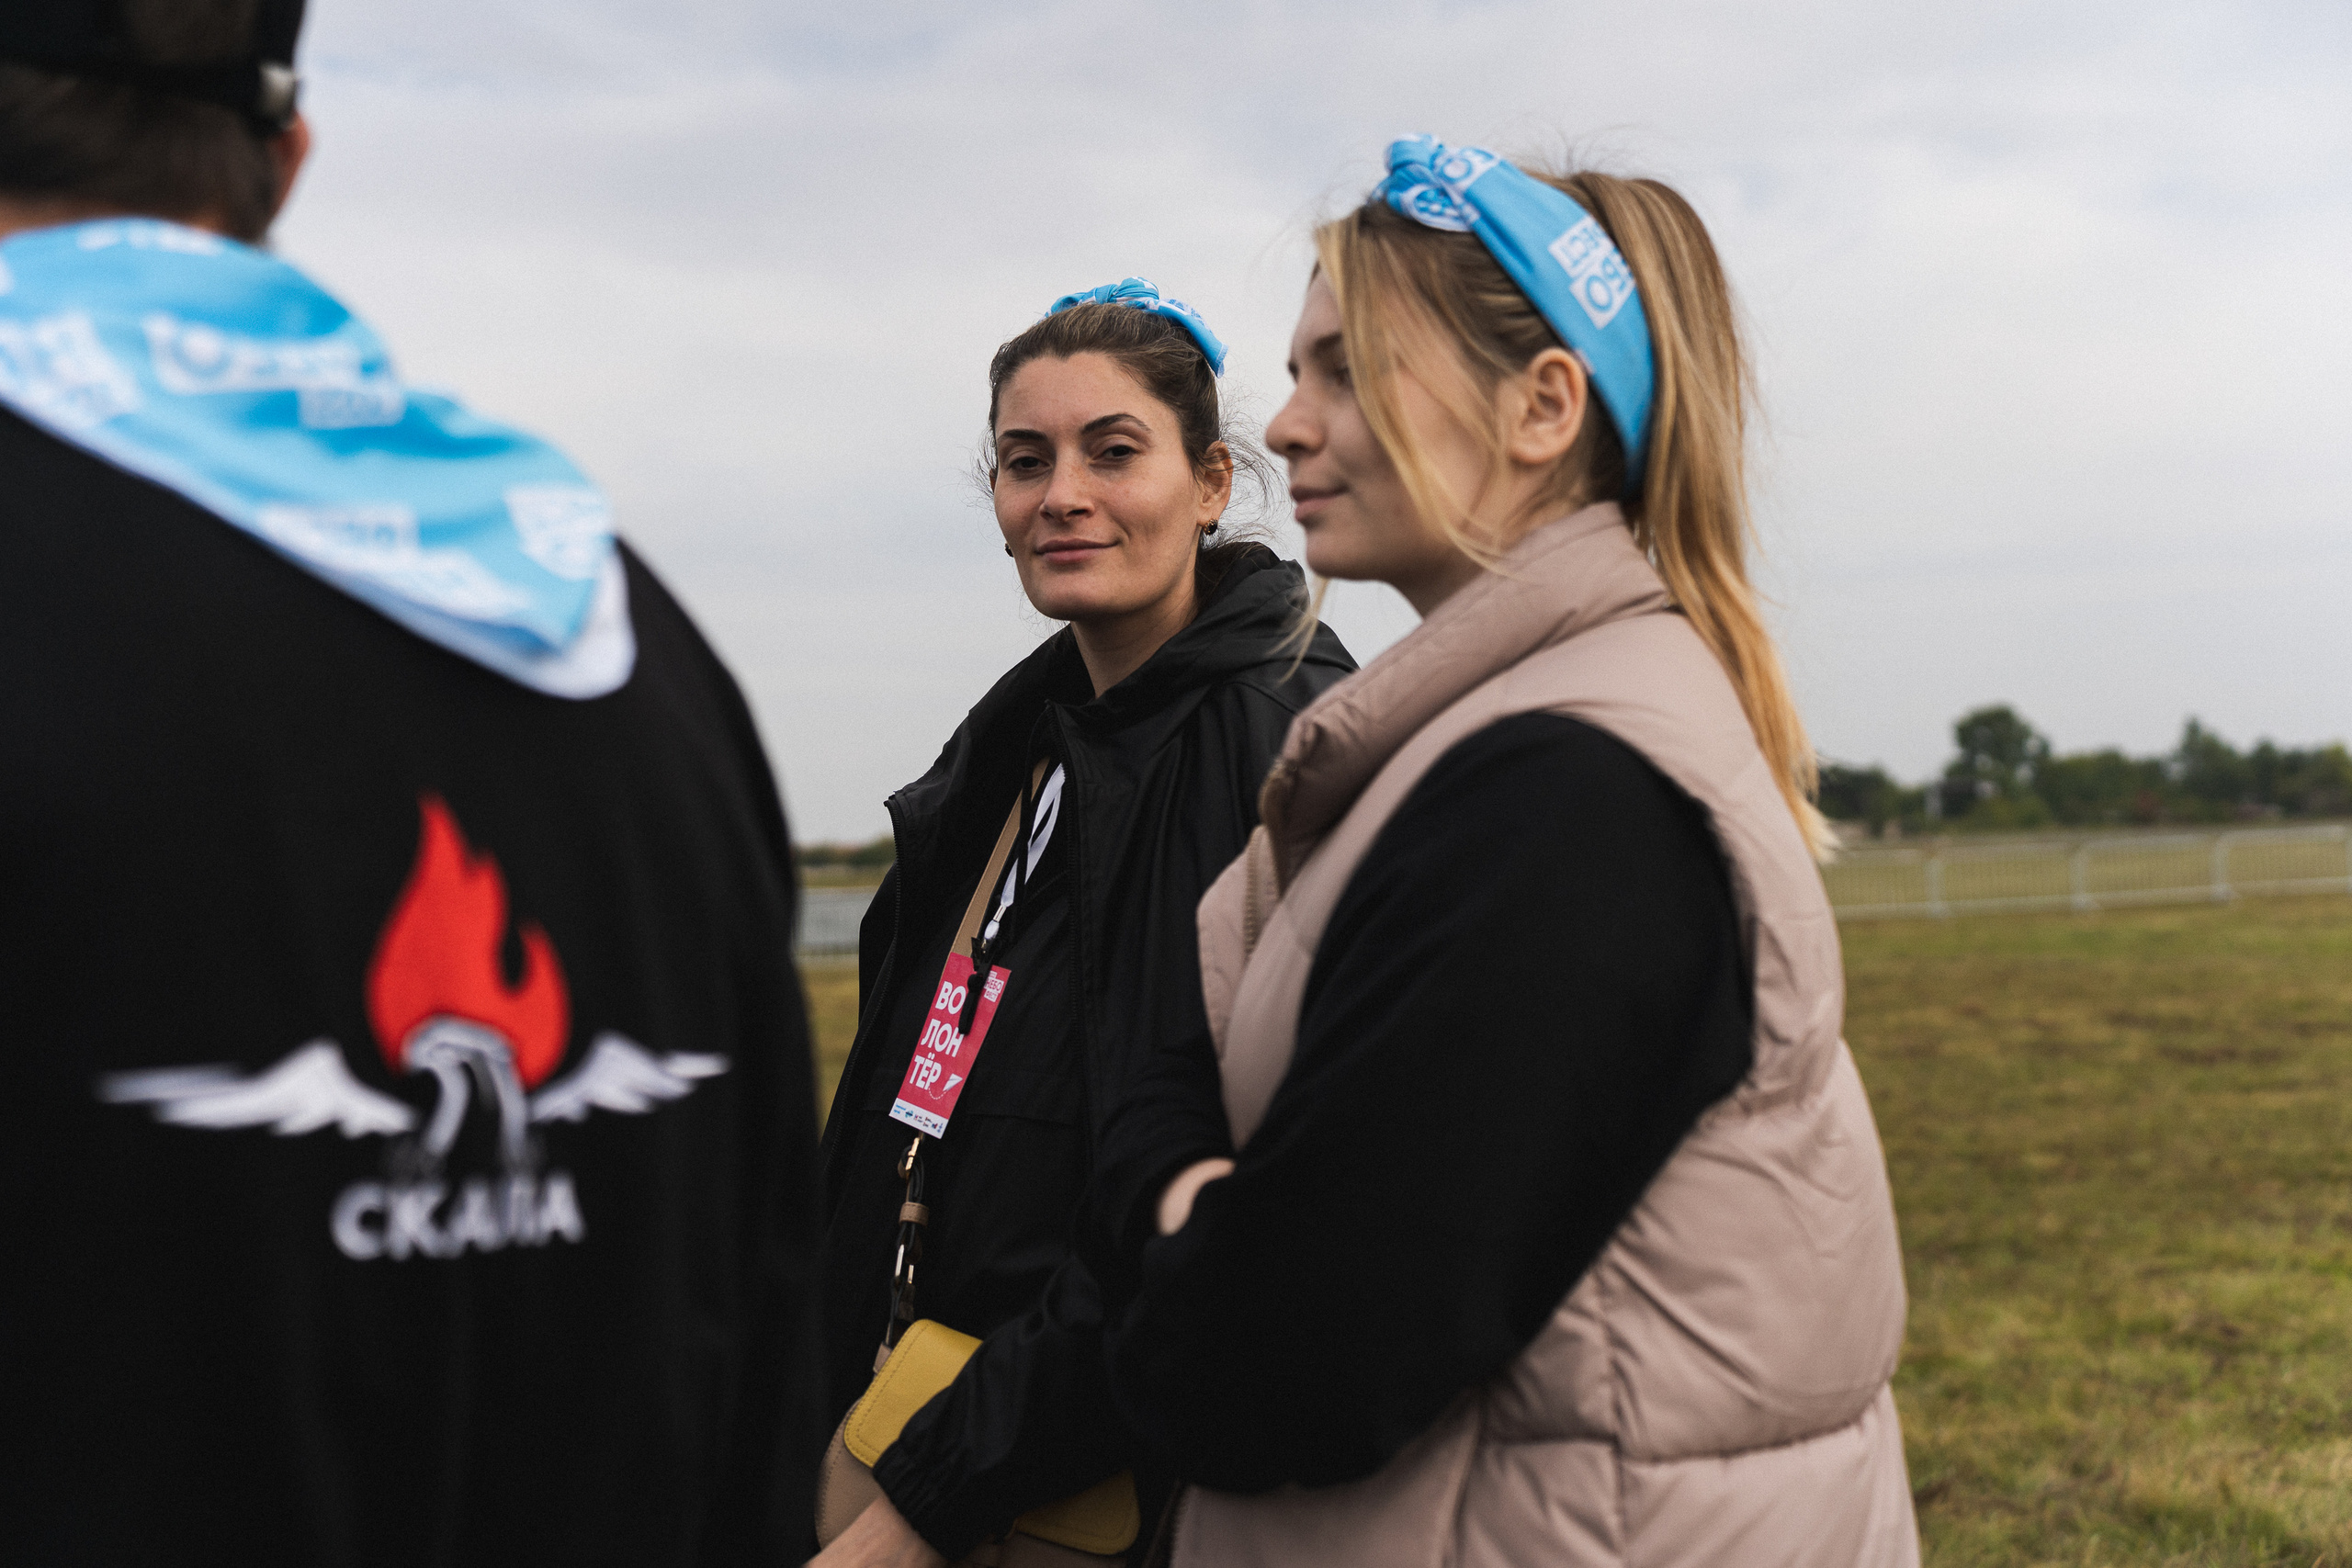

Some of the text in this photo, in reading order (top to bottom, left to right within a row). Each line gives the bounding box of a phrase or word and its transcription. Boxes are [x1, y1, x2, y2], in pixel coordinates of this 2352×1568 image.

[935, 981, 966, 1014] ВО
[921, 1019, 964, 1057] ЛОН
[910, 1053, 942, 1090] ТЁР
[330, 1172, 585, 1261] СКАЛА
